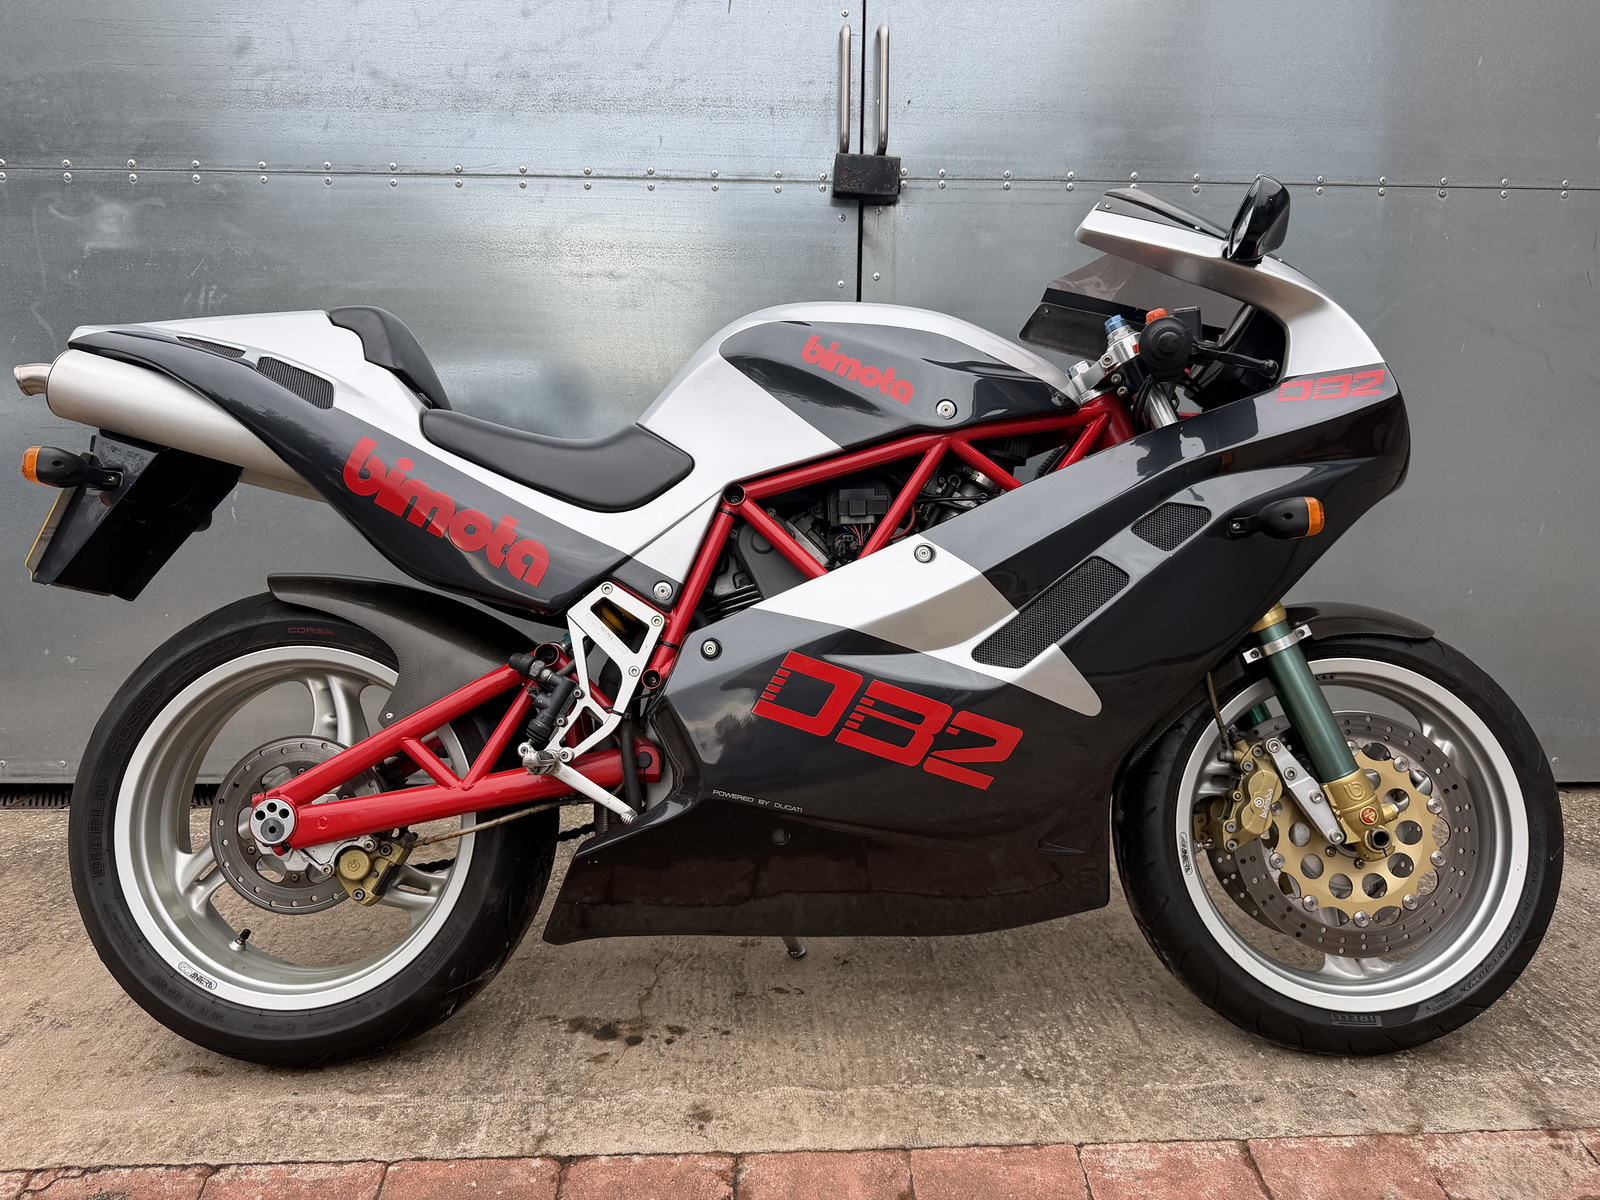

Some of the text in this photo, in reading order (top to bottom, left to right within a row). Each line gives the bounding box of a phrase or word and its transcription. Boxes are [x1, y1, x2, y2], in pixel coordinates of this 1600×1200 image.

[801, 334, 914, 405] bimota
[1276, 369, 1385, 402] DB2
[342, 435, 550, 588] bimota
[287, 626, 334, 636] CORSA
[752, 650, 1024, 791] DB2
[89, 638, 236, 878] DIABLO ROSSO CORSA
[712, 789, 755, 803] POWERED
[774, 802, 803, 813] DUCATI
[1259, 788, 1274, 819] brembo
